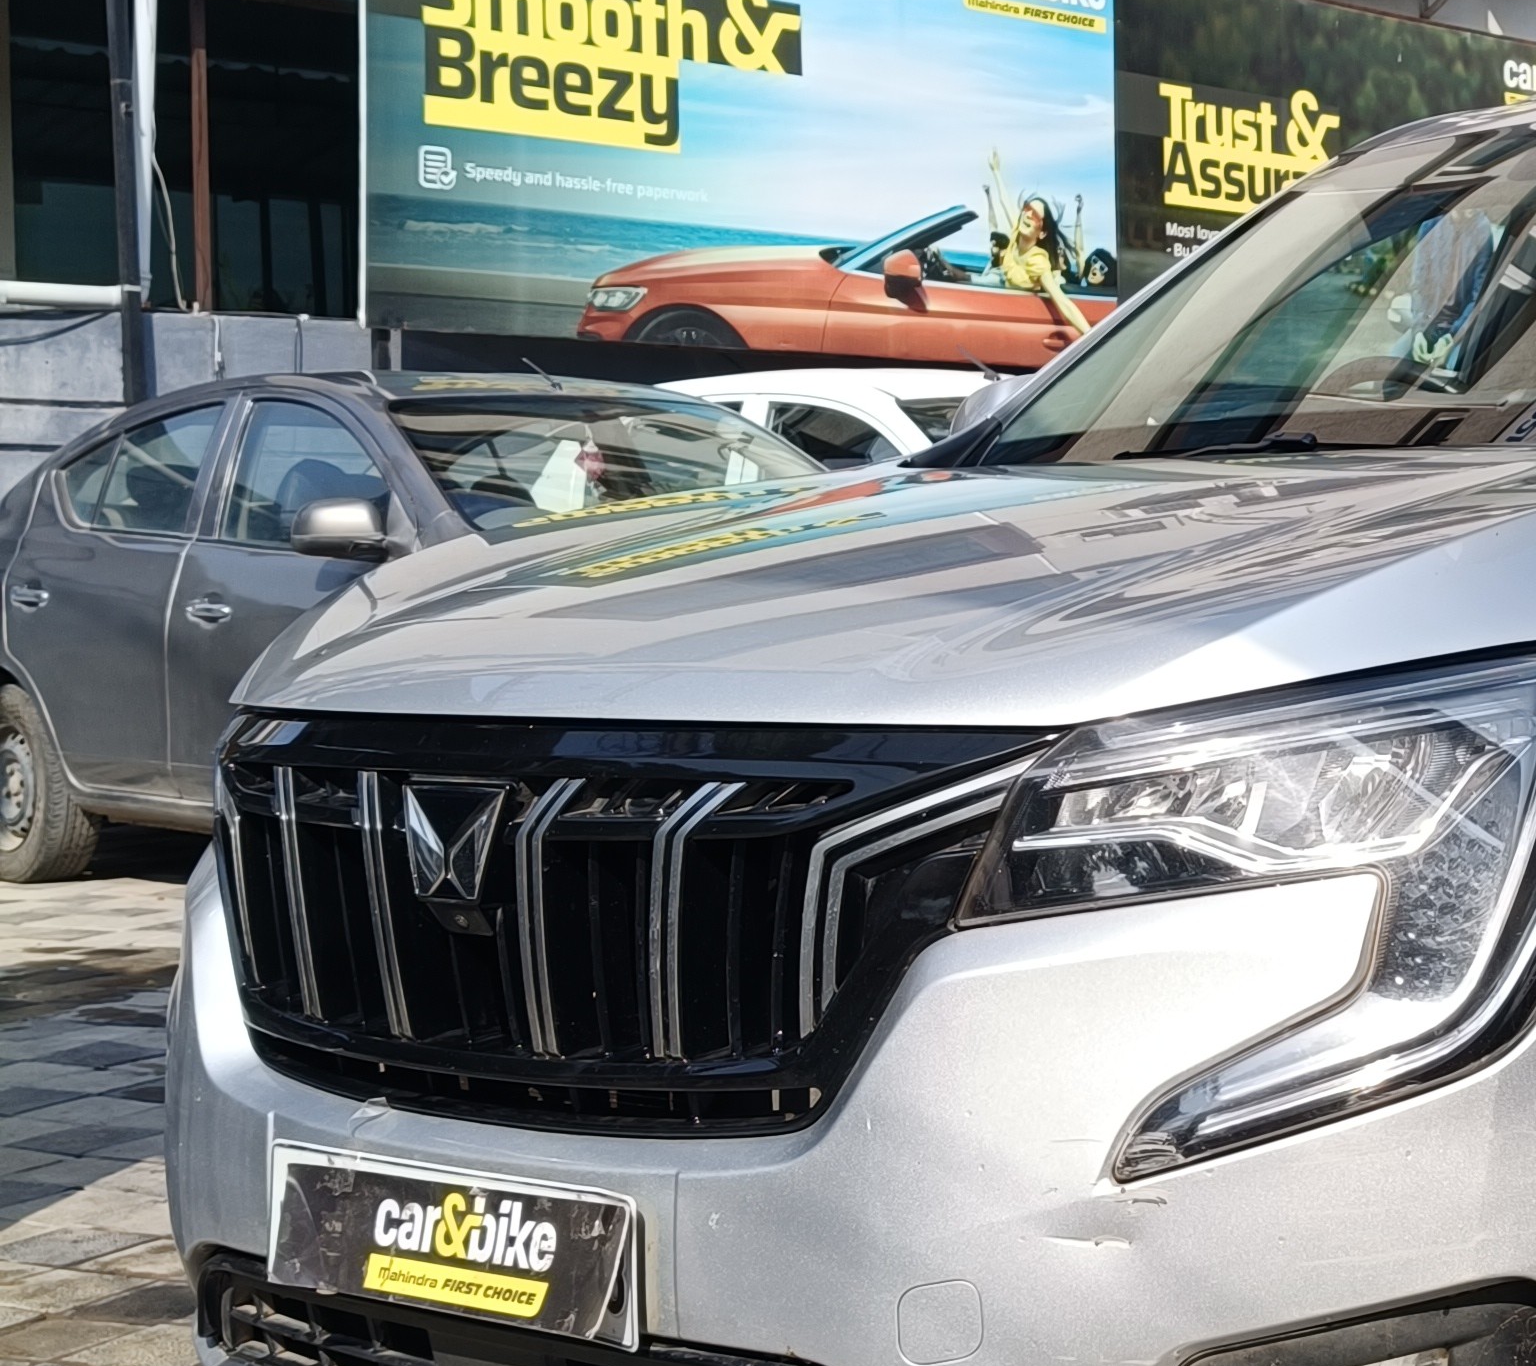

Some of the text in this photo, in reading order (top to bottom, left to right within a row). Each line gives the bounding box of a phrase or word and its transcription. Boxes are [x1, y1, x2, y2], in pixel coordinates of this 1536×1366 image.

[1023, 6, 1055, 21] FIRST
[1056, 12, 1096, 28] CHOICE
[425, 25, 680, 146] Breezy
[1159, 82, 1341, 160] Trust &
[463, 162, 710, 204] Speedy and hassle-free paperwork
[1163, 140, 1309, 205] Assur
[1165, 221, 1195, 239] Most
[374, 1192, 557, 1272] car&bike
[441, 1278, 483, 1296] FIRST
[482, 1284, 537, 1306] CHOICE
